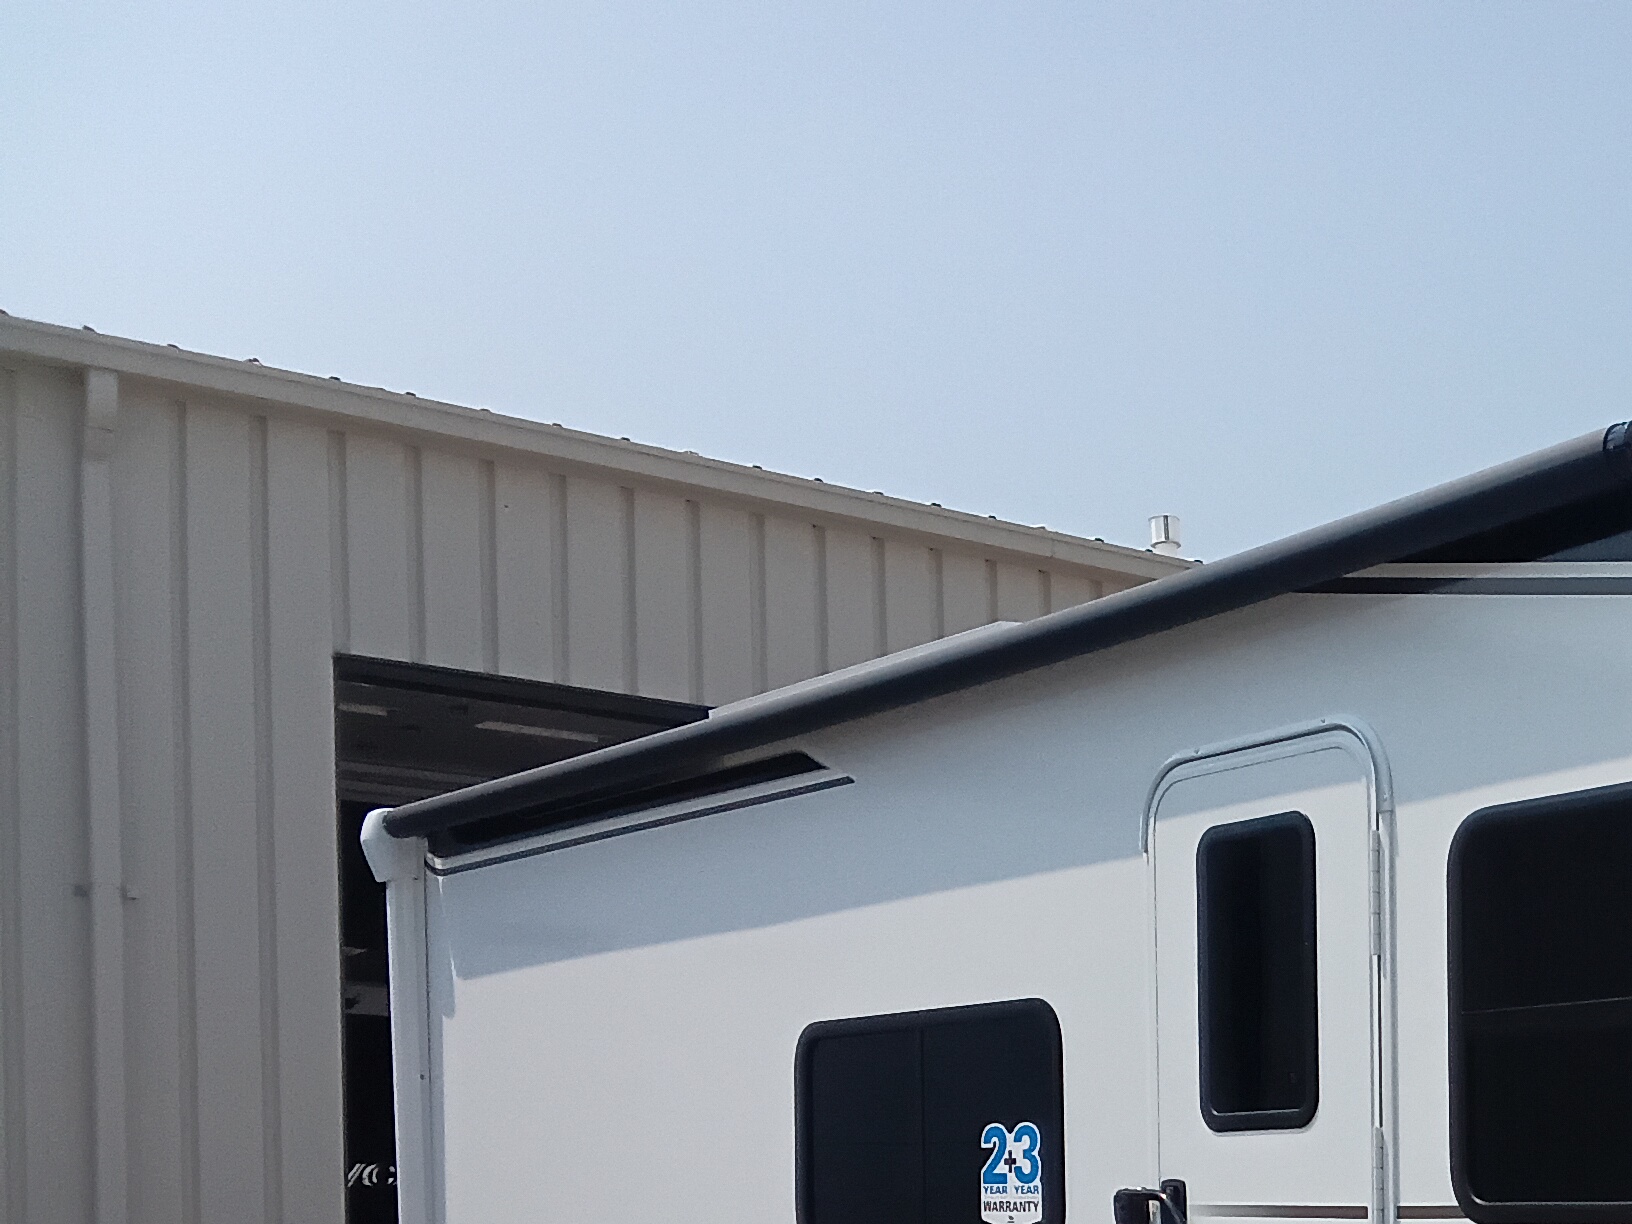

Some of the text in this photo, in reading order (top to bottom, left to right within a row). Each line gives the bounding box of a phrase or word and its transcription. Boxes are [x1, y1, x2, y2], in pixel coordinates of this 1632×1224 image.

[983, 1185, 1040, 1195] YEAR YEAR
[983, 1200, 1040, 1213] WARRANTY
